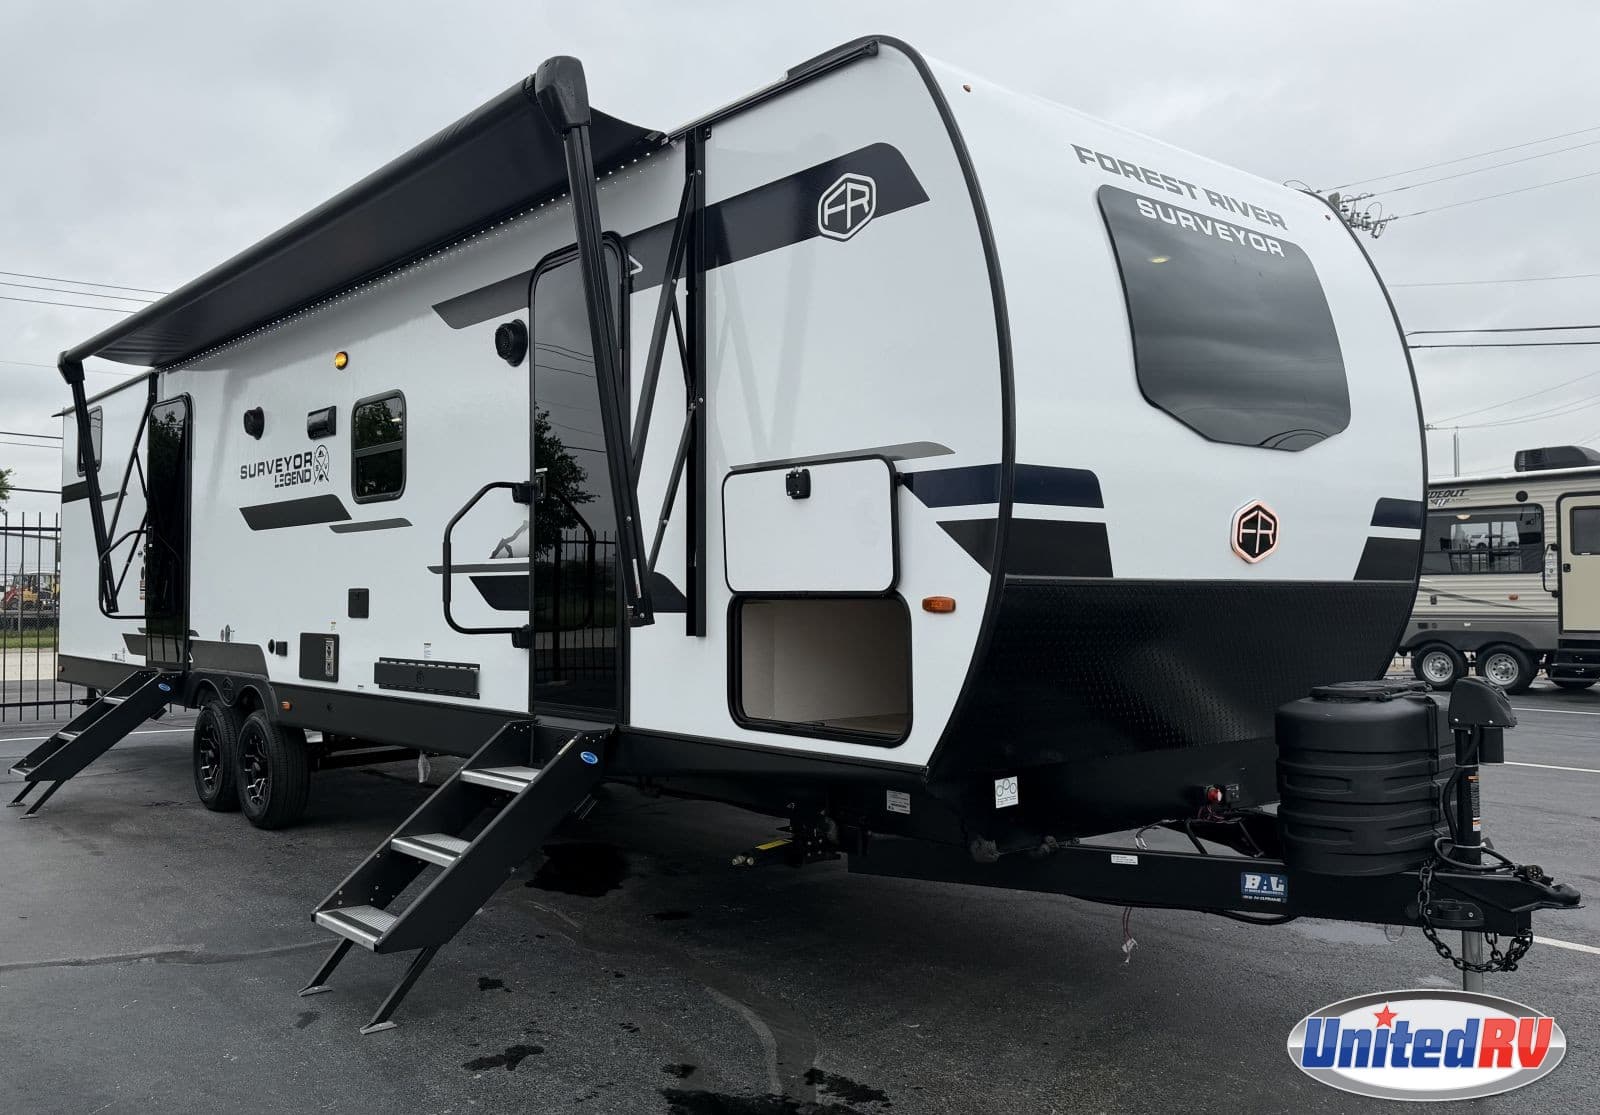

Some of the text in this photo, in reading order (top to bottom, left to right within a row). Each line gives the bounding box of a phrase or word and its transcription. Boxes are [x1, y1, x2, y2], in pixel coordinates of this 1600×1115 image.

[1070, 143, 1288, 230] FOREST RIVER
[1136, 198, 1285, 258] SURVEYOR
[240, 451, 313, 480] SURVEYOR
[274, 468, 312, 488] LEGEND
